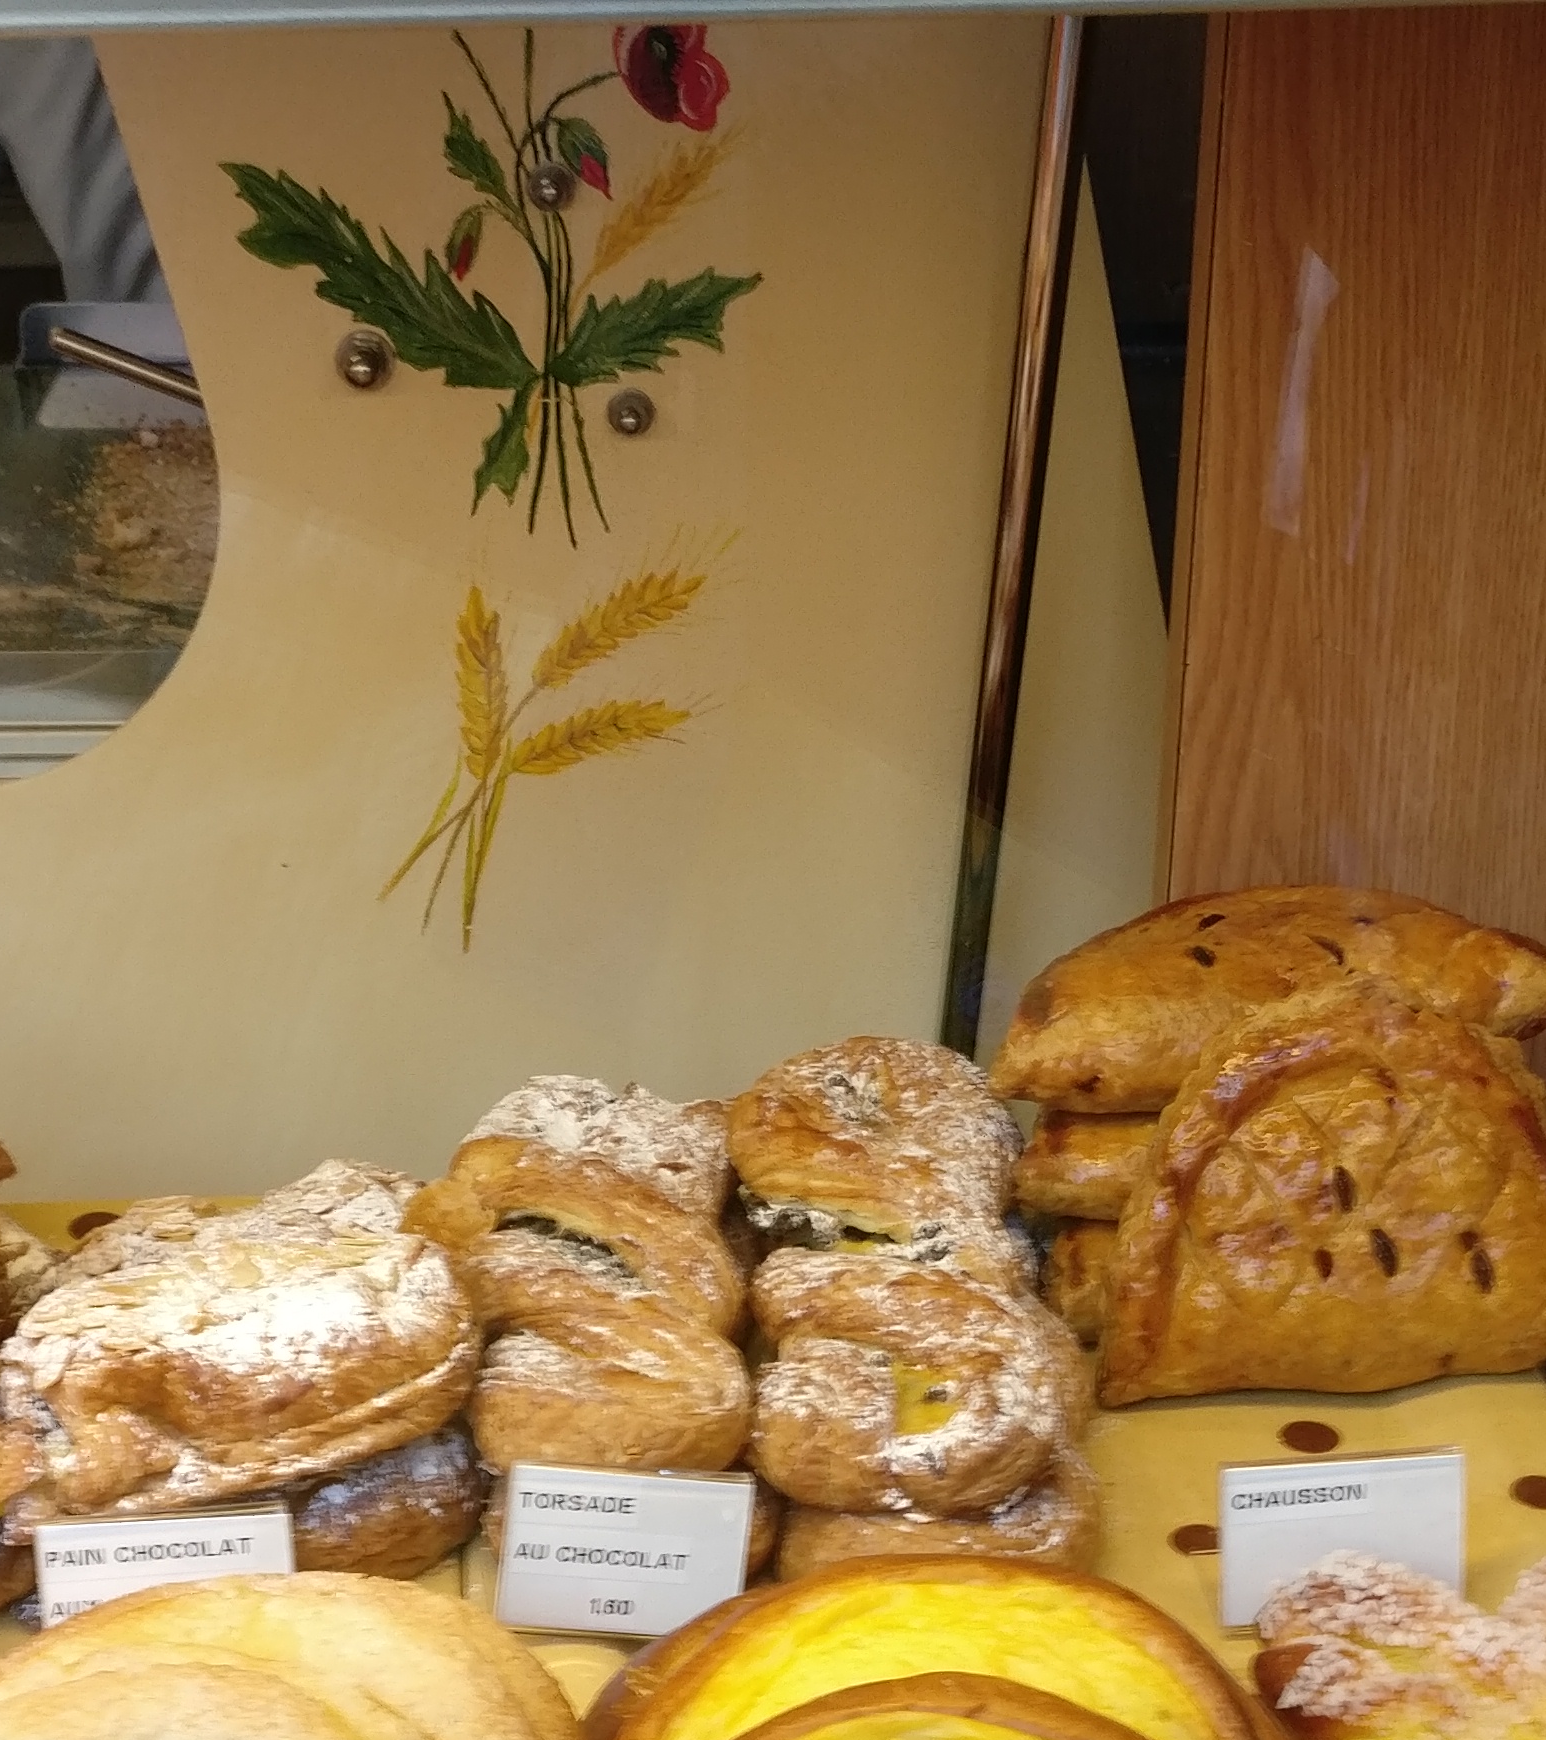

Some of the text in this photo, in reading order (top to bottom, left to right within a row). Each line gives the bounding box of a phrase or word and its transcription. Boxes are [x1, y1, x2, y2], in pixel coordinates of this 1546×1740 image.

[519, 1491, 638, 1514] TORSADE
[1230, 1483, 1368, 1510] CHAUSSON
[44, 1537, 254, 1568] PAIN CHOCOLAT
[513, 1542, 690, 1570] AU CHOCOLAT
